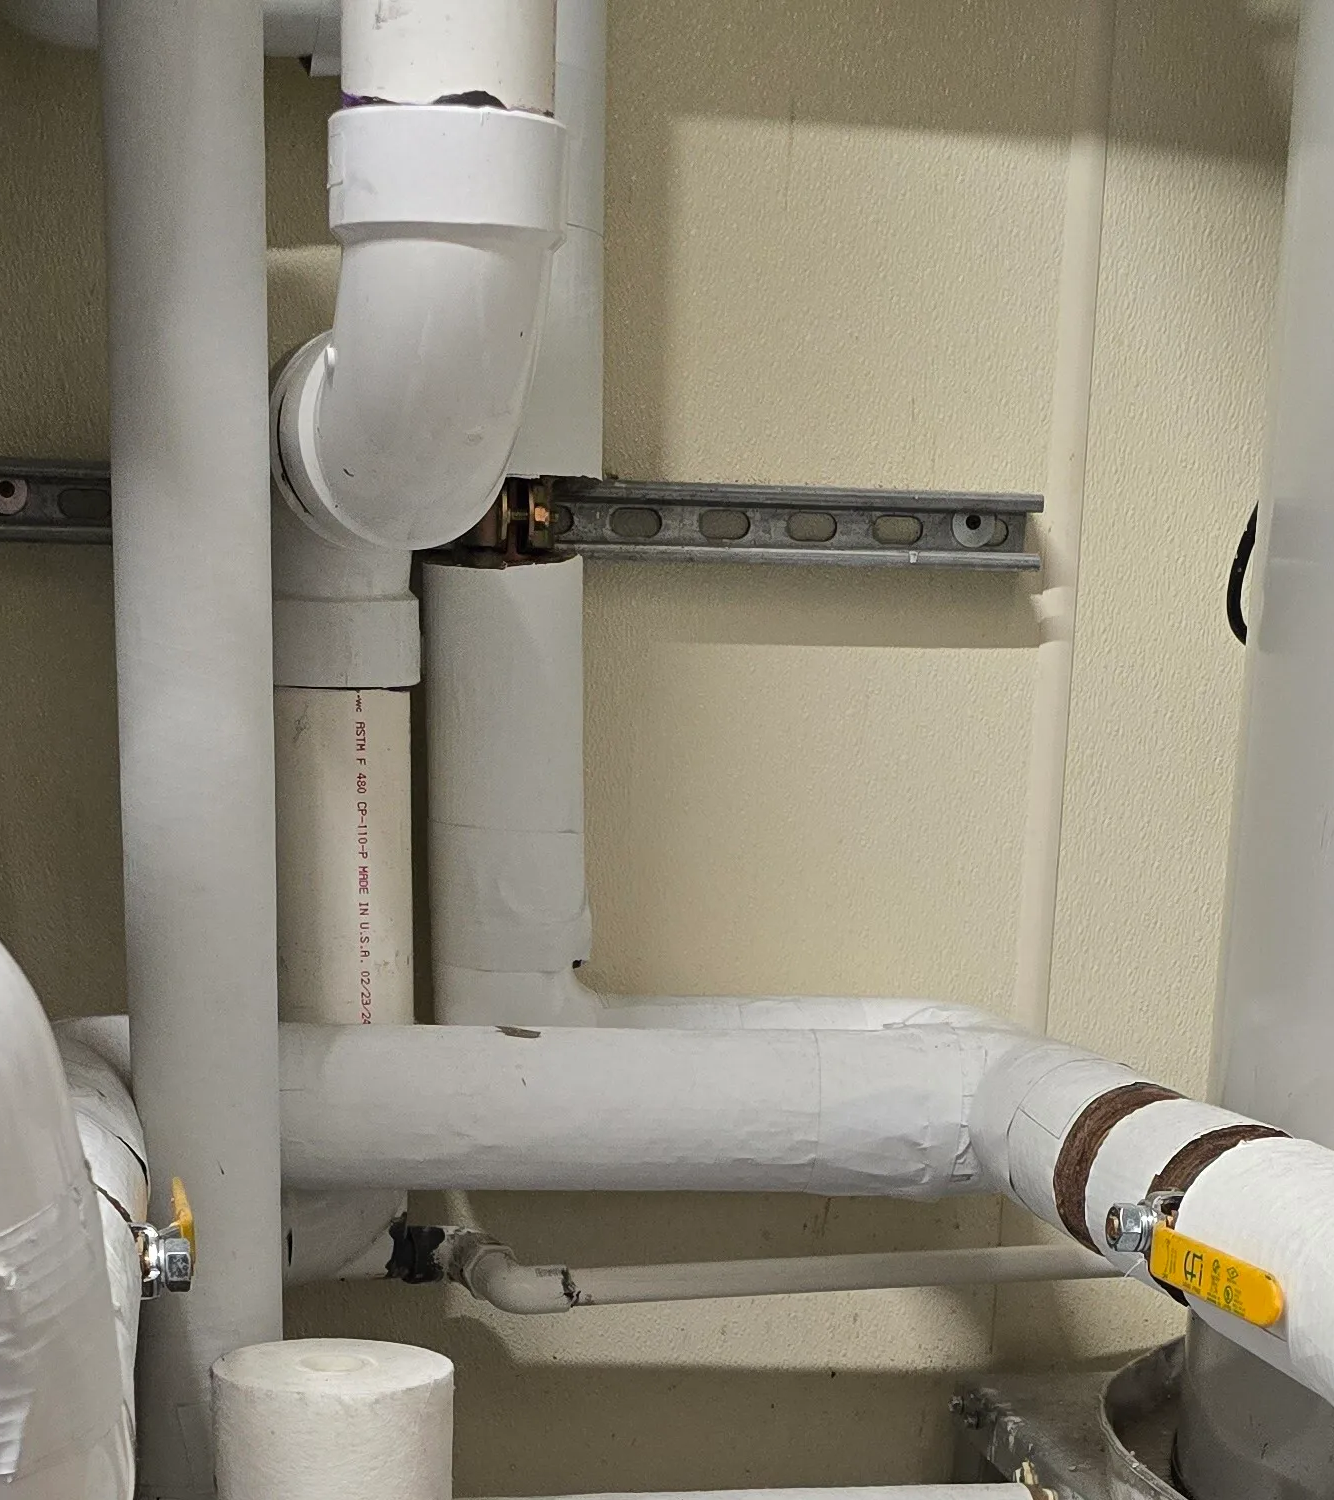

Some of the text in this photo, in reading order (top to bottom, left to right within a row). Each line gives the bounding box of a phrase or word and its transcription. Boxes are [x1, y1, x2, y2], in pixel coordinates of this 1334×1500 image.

[356, 722, 365, 751] ASTM
[357, 773, 367, 794] 480
[357, 802, 367, 859] CP-110-P
[358, 866, 369, 894] MADE
[359, 903, 369, 915] IN
[360, 922, 370, 963] U.S.A.
[361, 971, 371, 1025] 02/23/24
